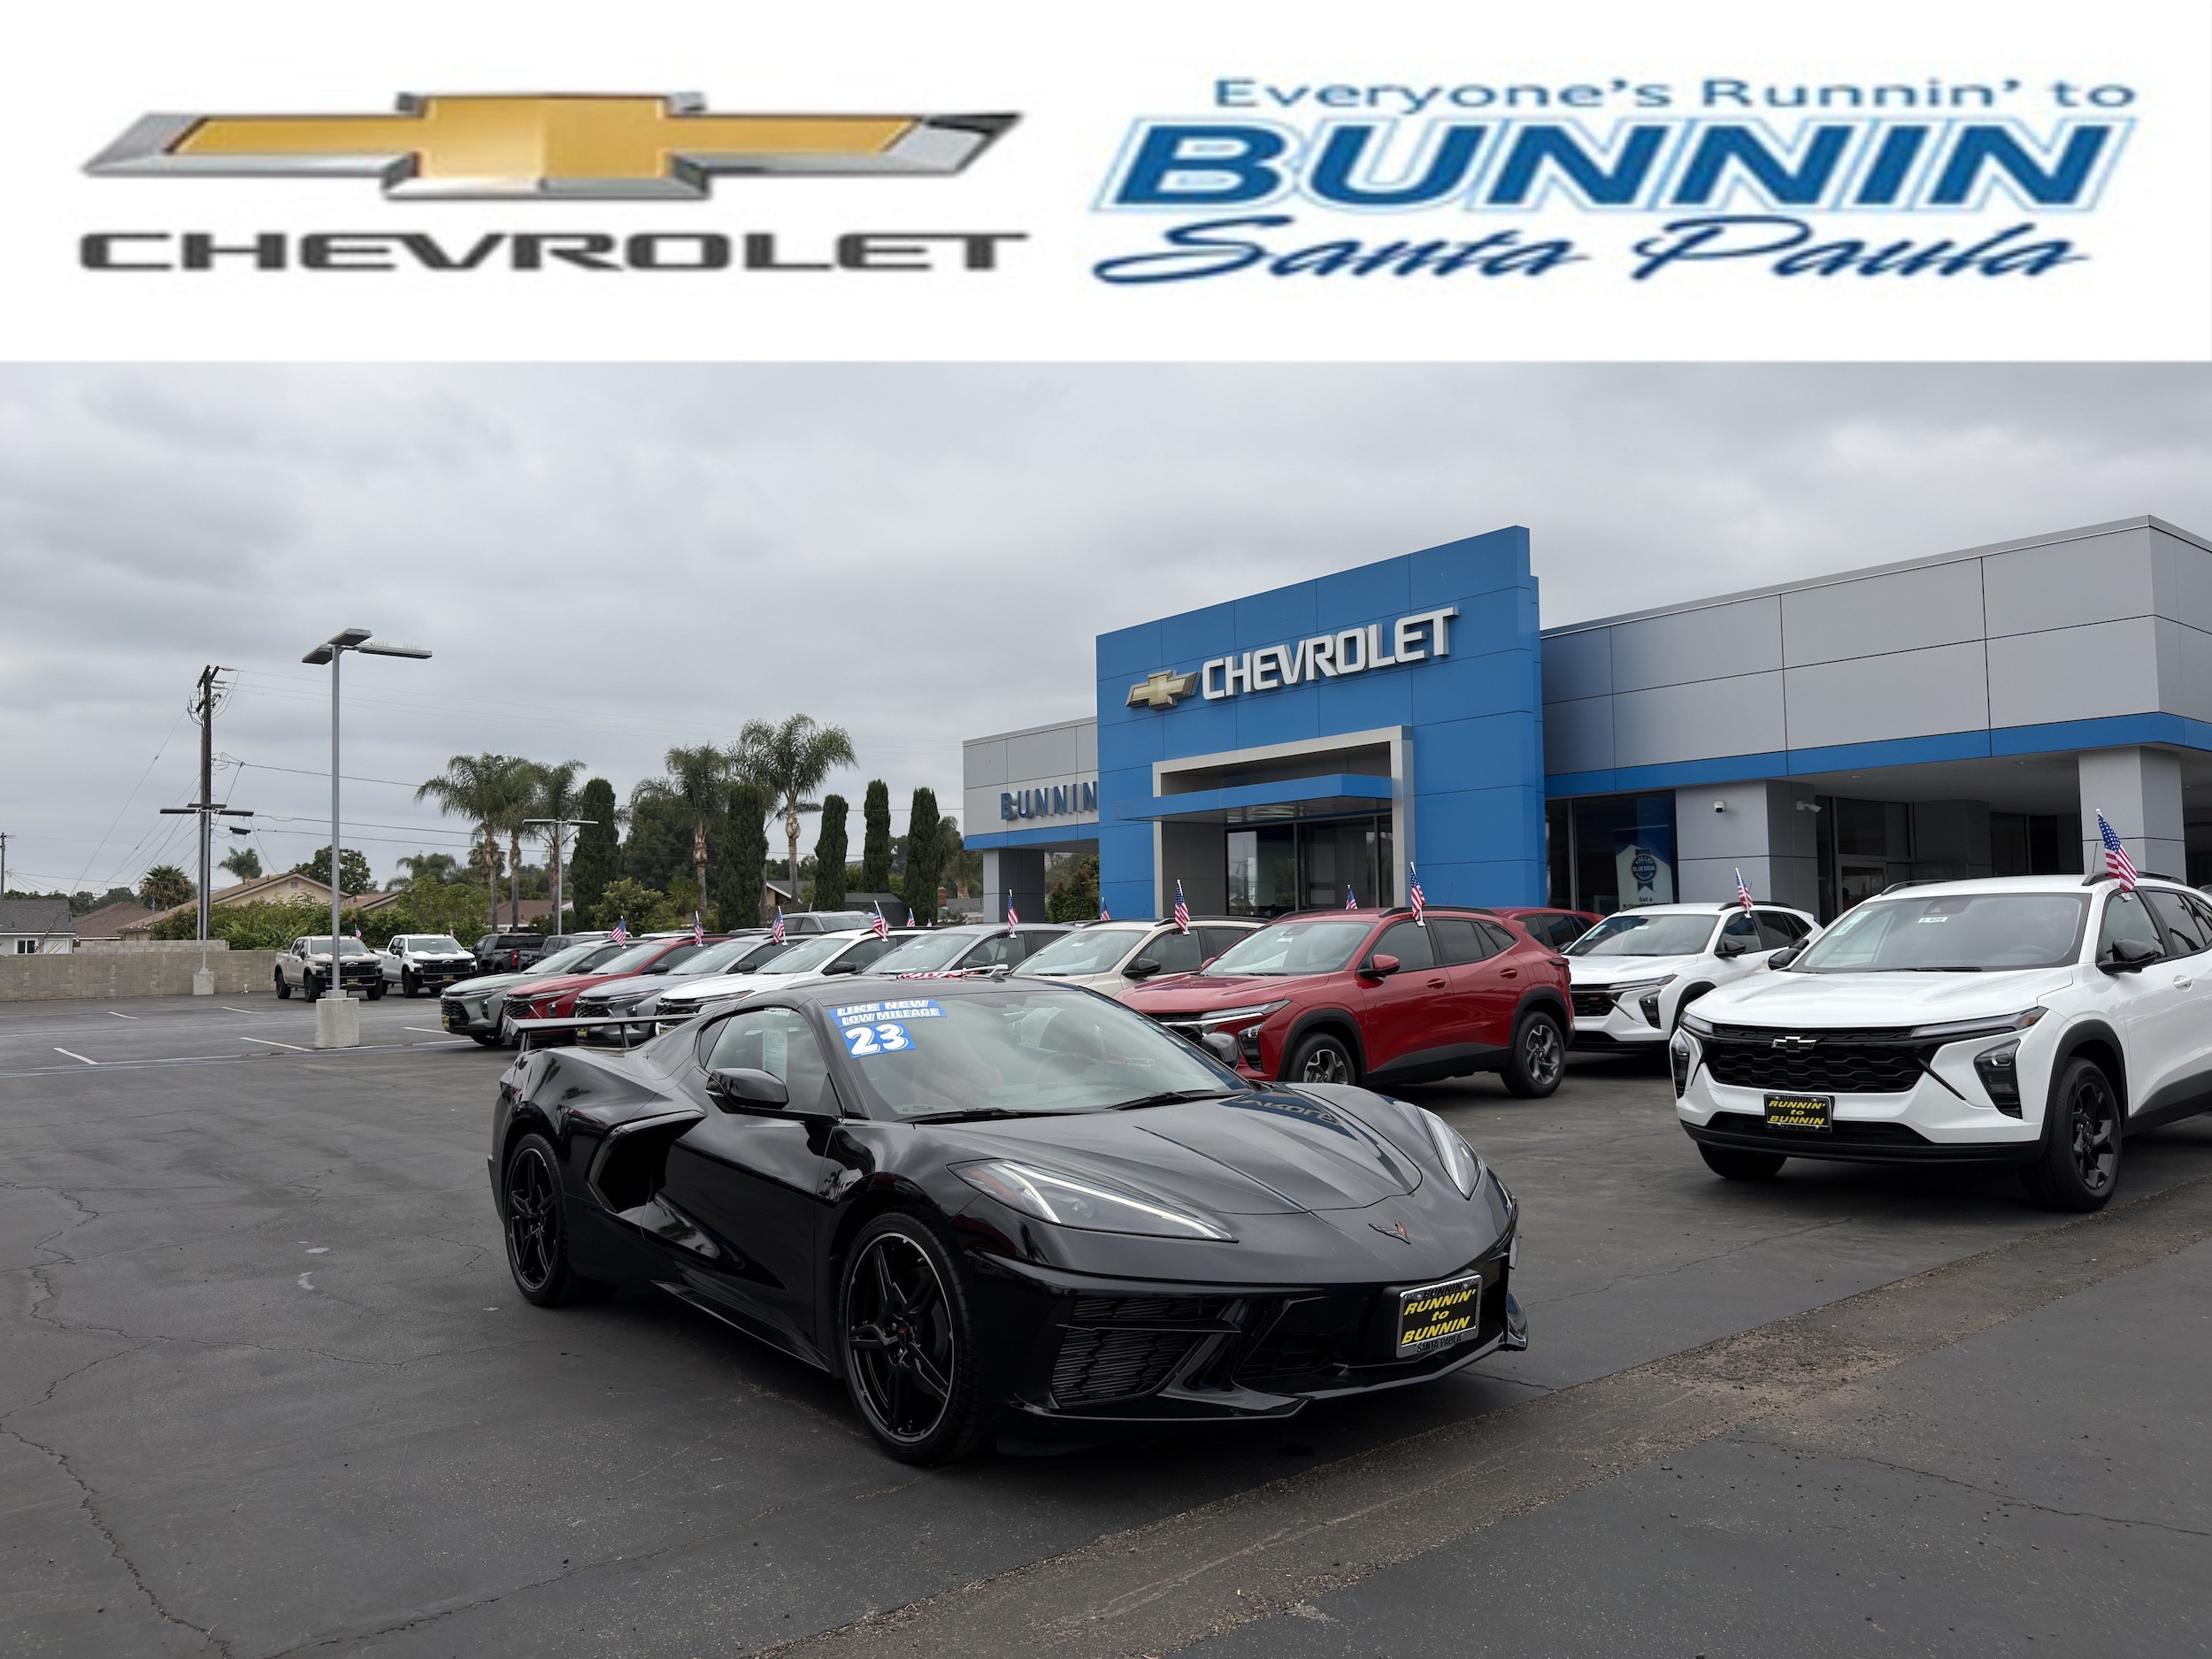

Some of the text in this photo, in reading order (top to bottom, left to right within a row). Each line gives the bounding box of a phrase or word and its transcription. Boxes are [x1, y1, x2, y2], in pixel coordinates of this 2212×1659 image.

[1202, 607, 1459, 700] CHEVROLET
[1001, 781, 1097, 820] BUNNIN
[837, 1000, 929, 1017] LIKE NEW
[841, 1008, 941, 1025] LOW MILEAGE
[845, 1024, 909, 1056] 23
[1769, 1100, 1825, 1110] RUNNIN'
[1770, 1115, 1824, 1125] BUNNIN
[1403, 1289, 1477, 1316] RUNNIN'
[1432, 1310, 1449, 1321] to
[1401, 1316, 1471, 1344] BUNNIN
